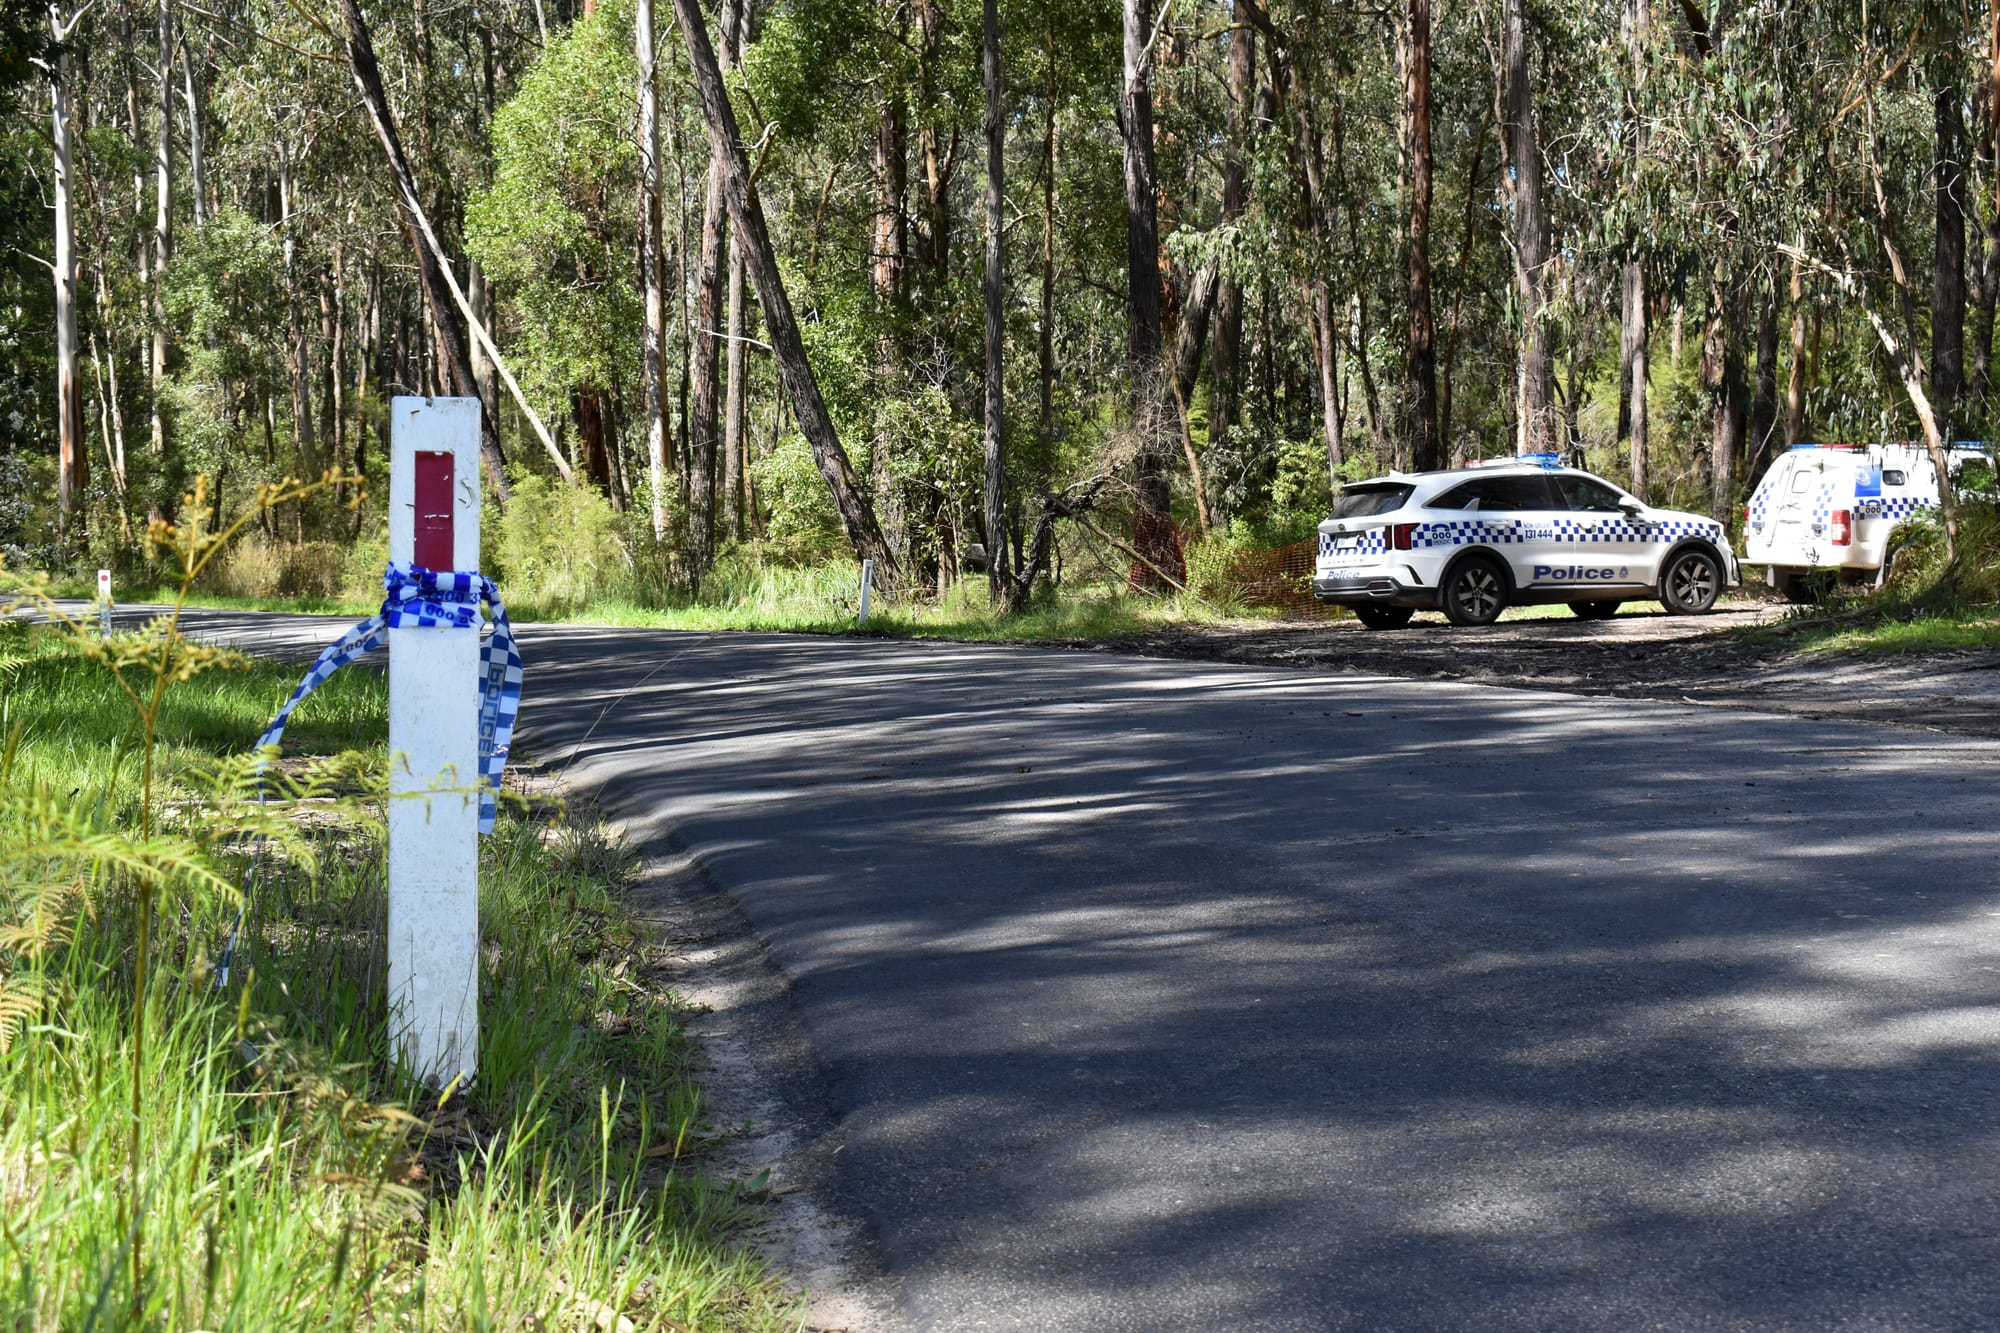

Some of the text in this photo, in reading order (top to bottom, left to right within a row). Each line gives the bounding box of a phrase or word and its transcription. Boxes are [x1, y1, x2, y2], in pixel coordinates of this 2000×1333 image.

[1432, 532, 1451, 540] 000
[1327, 570, 1360, 579] Police
[1533, 565, 1615, 580] Police
